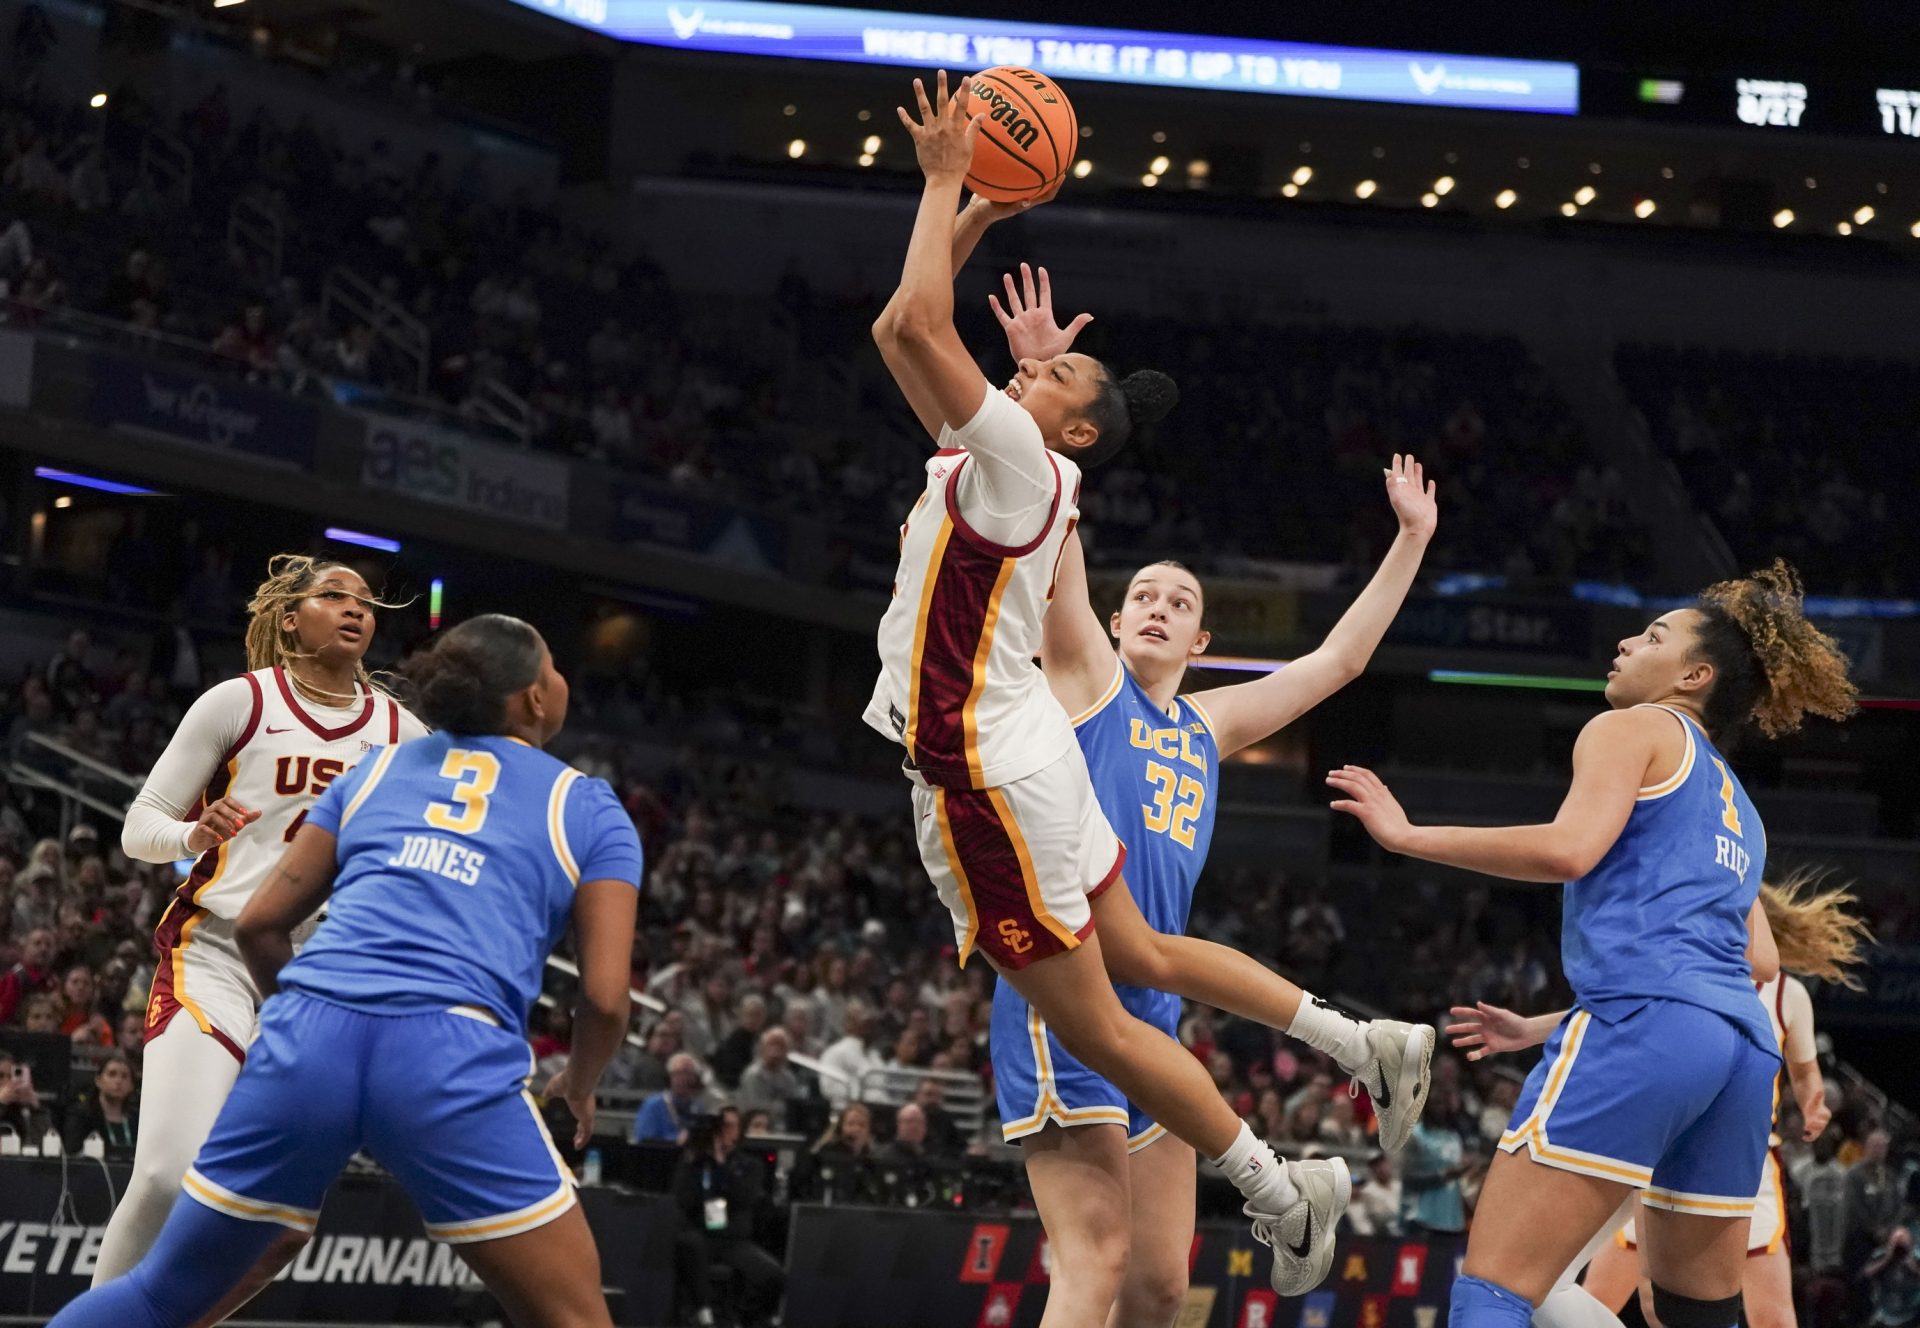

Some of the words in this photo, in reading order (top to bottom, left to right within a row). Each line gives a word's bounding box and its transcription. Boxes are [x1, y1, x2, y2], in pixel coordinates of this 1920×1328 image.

[862, 28, 969, 62] WHERE
[972, 35, 1033, 66] YOU
[1037, 40, 1115, 73] TAKE
[1119, 46, 1151, 74] IT
[1155, 50, 1187, 78] IS
[1191, 51, 1233, 80] UP
[1237, 55, 1277, 85] TO
[1281, 58, 1342, 90] YOU
[970, 80, 1039, 153] Wilson
[369, 429, 461, 494] aes
[274, 756, 358, 798] US
[423, 749, 502, 835] 3
[1142, 759, 1206, 850] 32
[1709, 753, 1743, 838] 1
[387, 834, 486, 887] JONES
[273, 1235, 487, 1291] URNAM
